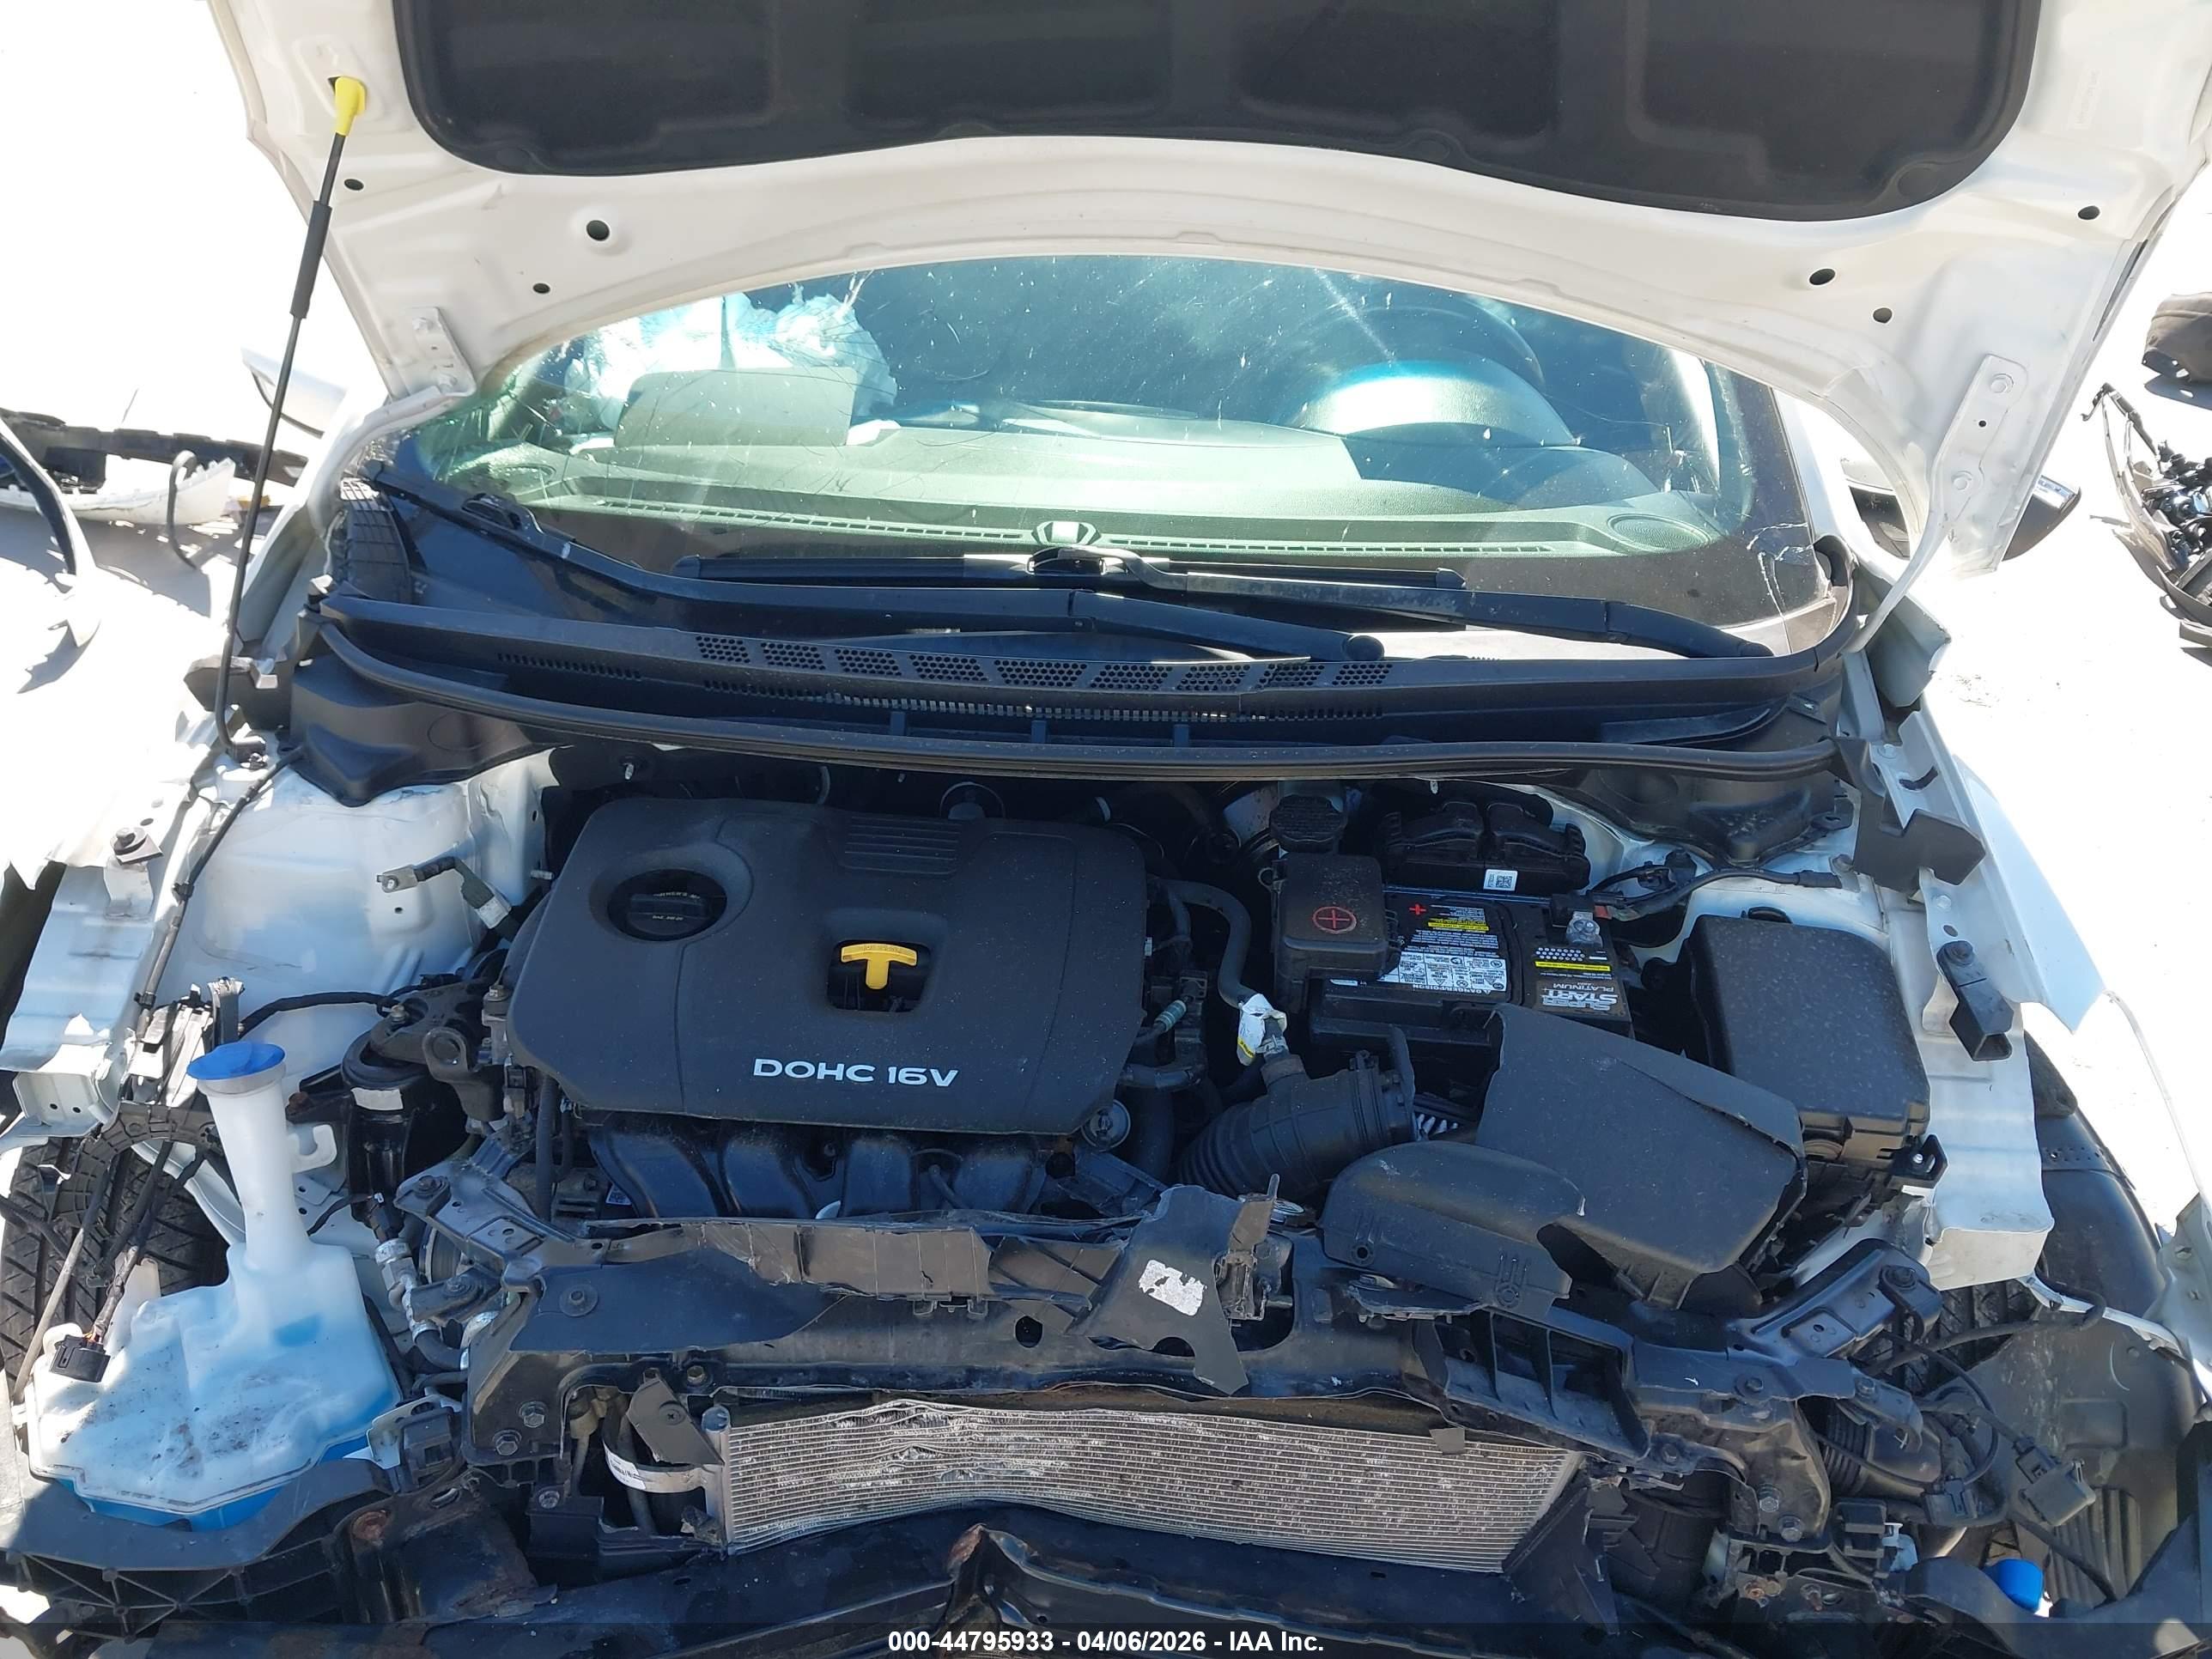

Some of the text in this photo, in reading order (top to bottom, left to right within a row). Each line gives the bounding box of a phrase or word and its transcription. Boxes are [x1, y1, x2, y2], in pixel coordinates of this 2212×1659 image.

[1553, 982, 1614, 993] PLATINUM
[1541, 996, 1611, 1012] SUPER
[1547, 989, 1619, 1006] START
[753, 1058, 959, 1087] DOHC 16V
